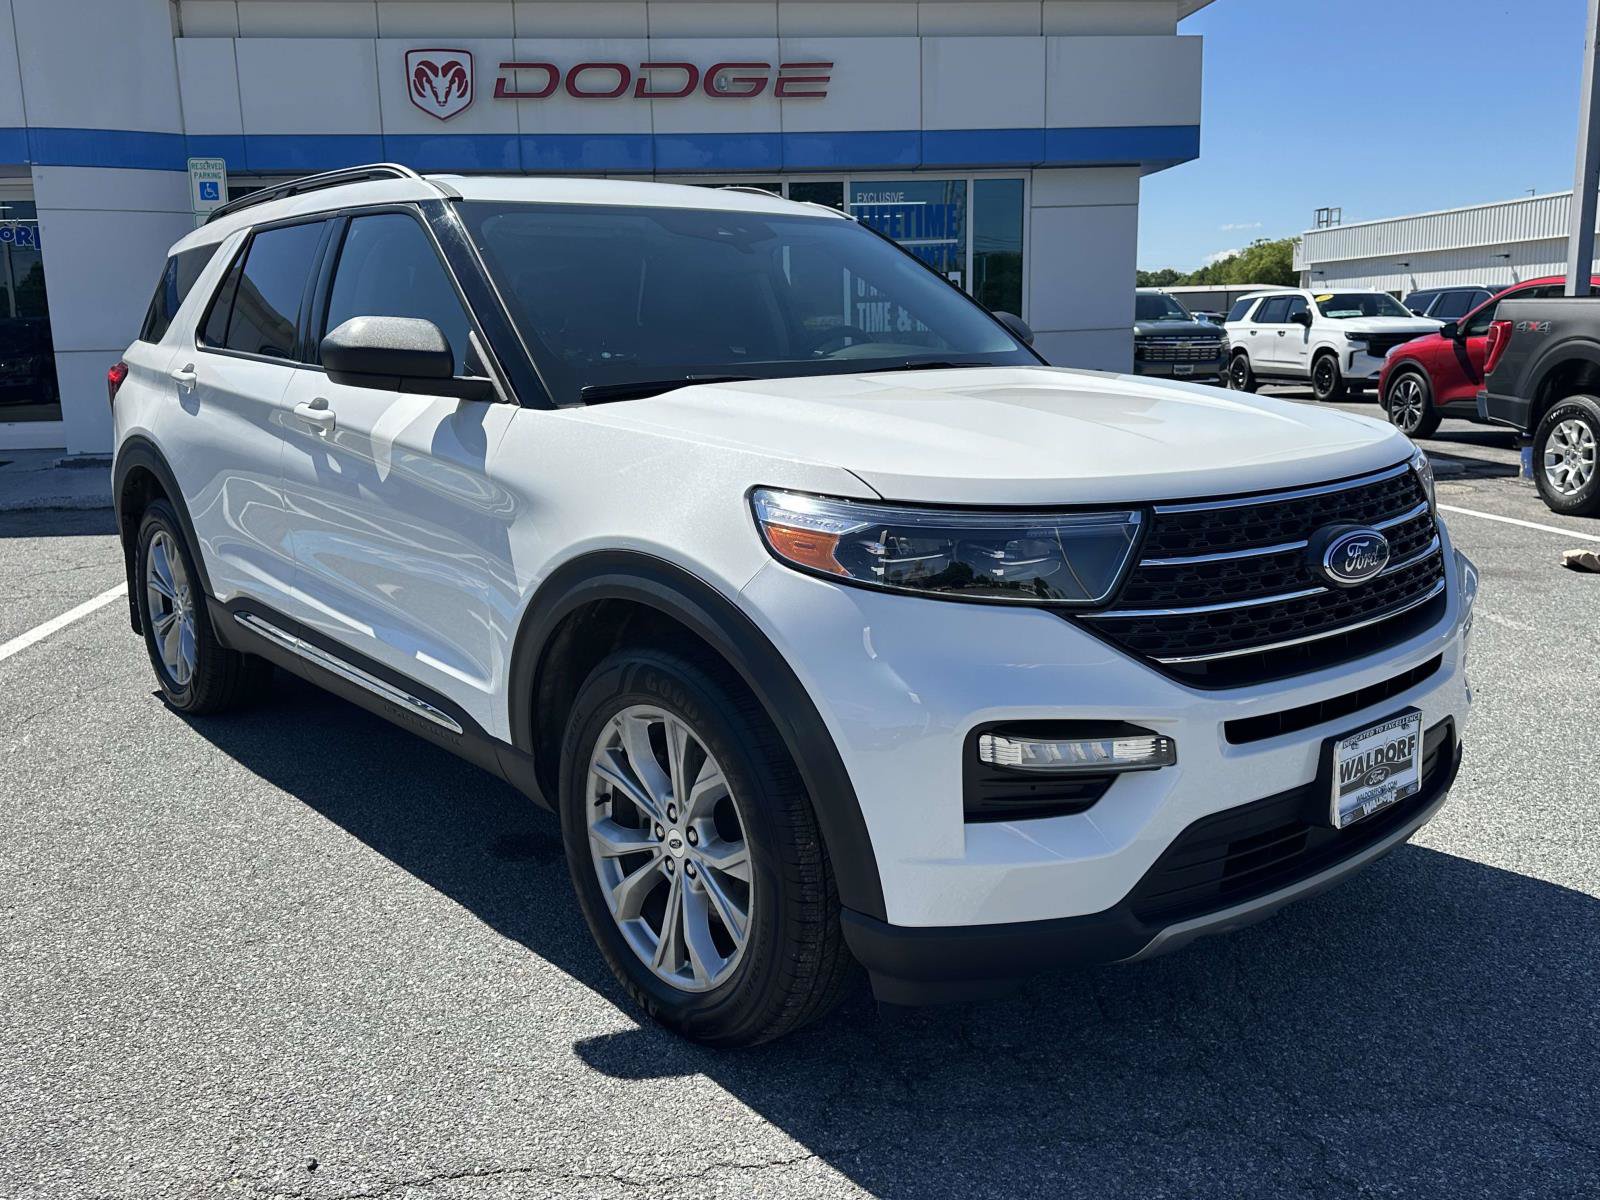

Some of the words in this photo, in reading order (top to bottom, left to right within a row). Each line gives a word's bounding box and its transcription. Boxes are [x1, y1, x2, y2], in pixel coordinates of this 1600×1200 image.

[493, 62, 834, 99] DODGE
[190, 162, 223, 170] RESERVED
[193, 171, 222, 179] PARKING
[857, 191, 905, 204] EXCLUSIVE
[856, 302, 892, 333] TIME
[1344, 540, 1380, 573] Ford
[1340, 732, 1417, 784] WALDORF
